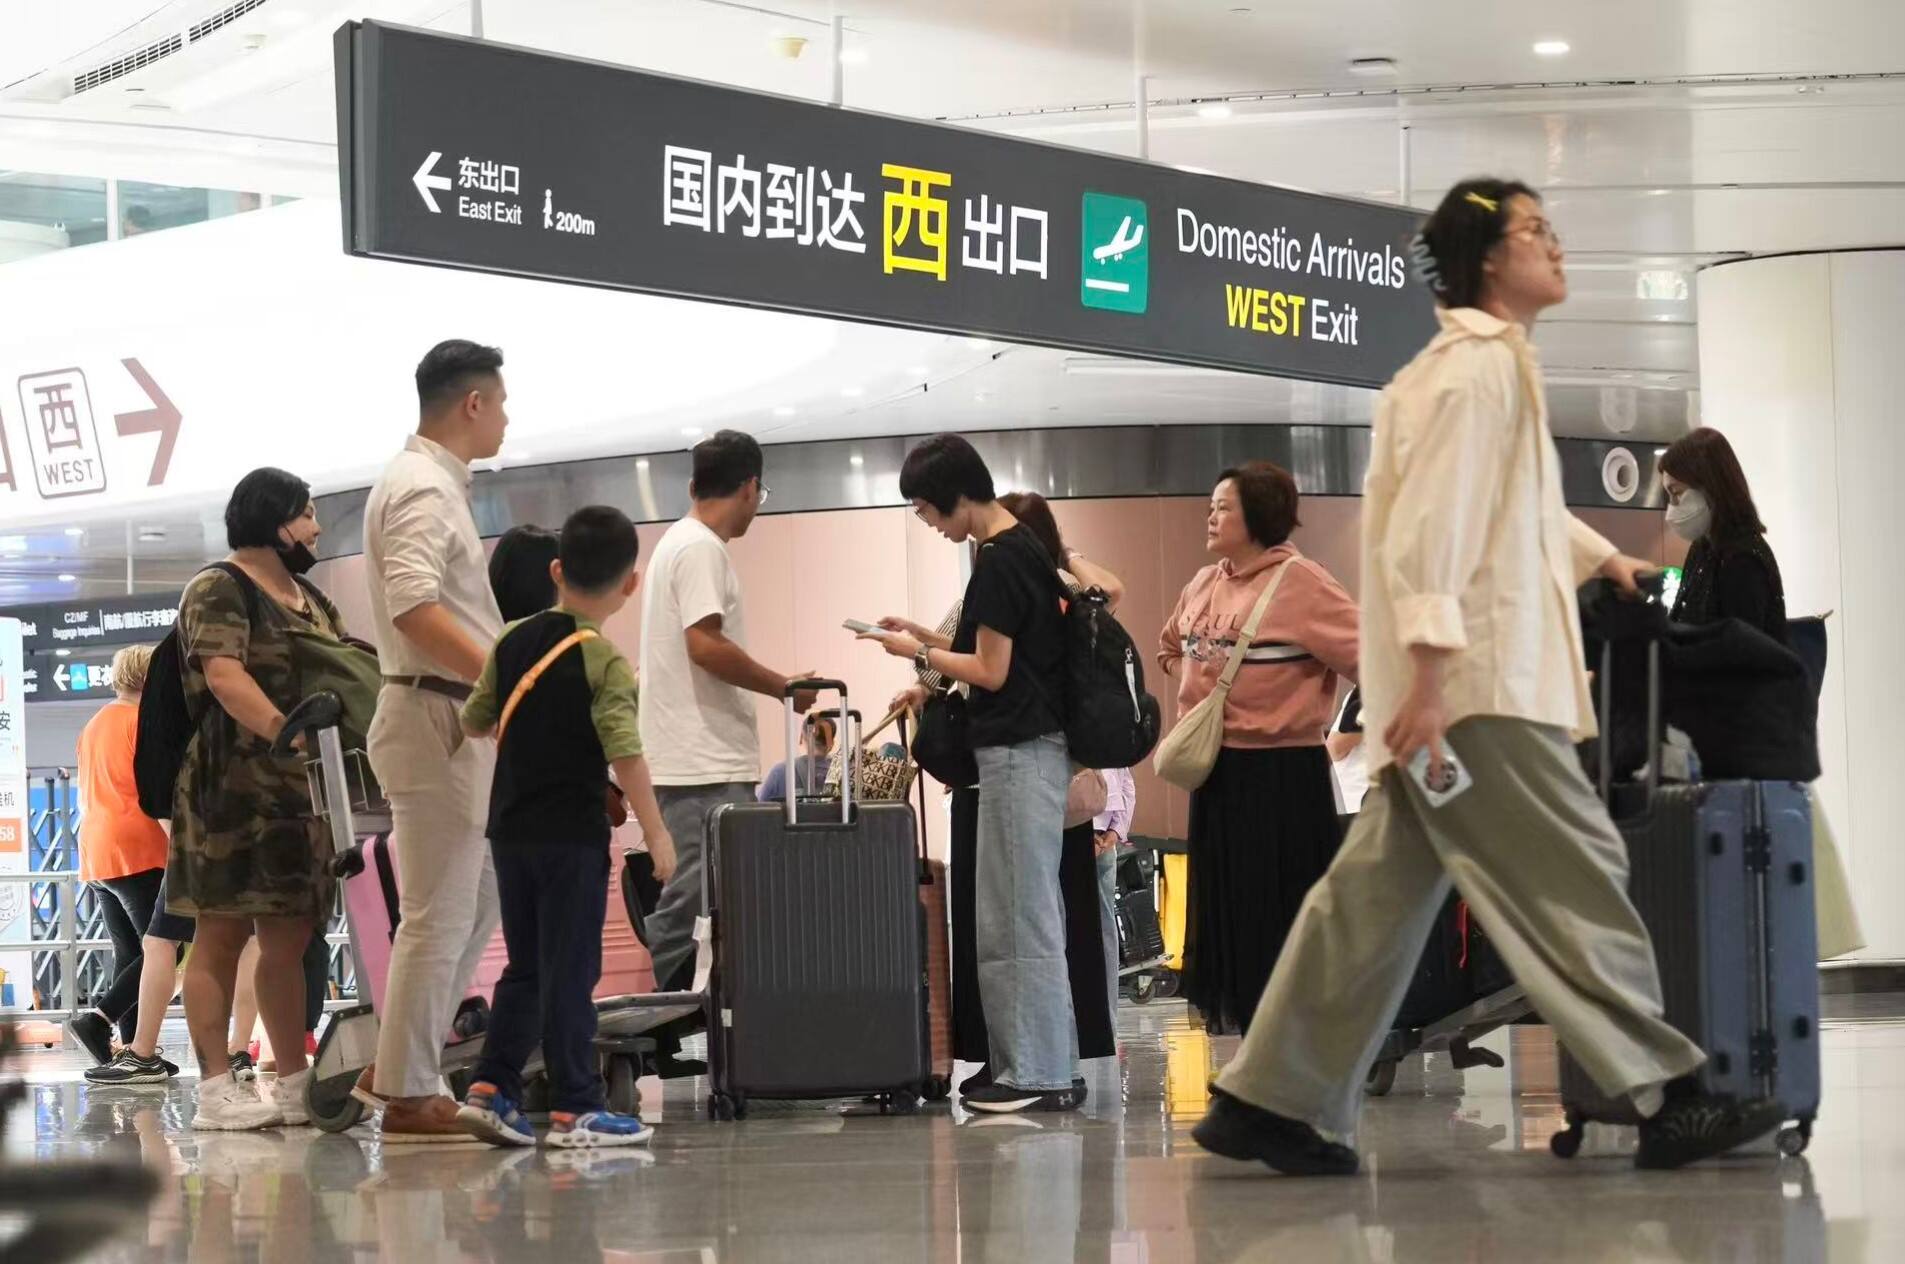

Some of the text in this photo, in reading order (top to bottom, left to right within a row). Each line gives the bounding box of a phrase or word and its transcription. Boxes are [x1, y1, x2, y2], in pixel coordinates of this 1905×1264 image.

[458, 157, 520, 196] 东出口
[458, 195, 523, 226] East Exit
[555, 211, 596, 236] 200m
[1176, 207, 1405, 289] Domestic Arrivals
[1225, 283, 1359, 346] WEST Exit
[33, 382, 83, 454] 西
[43, 458, 95, 485] WEST
